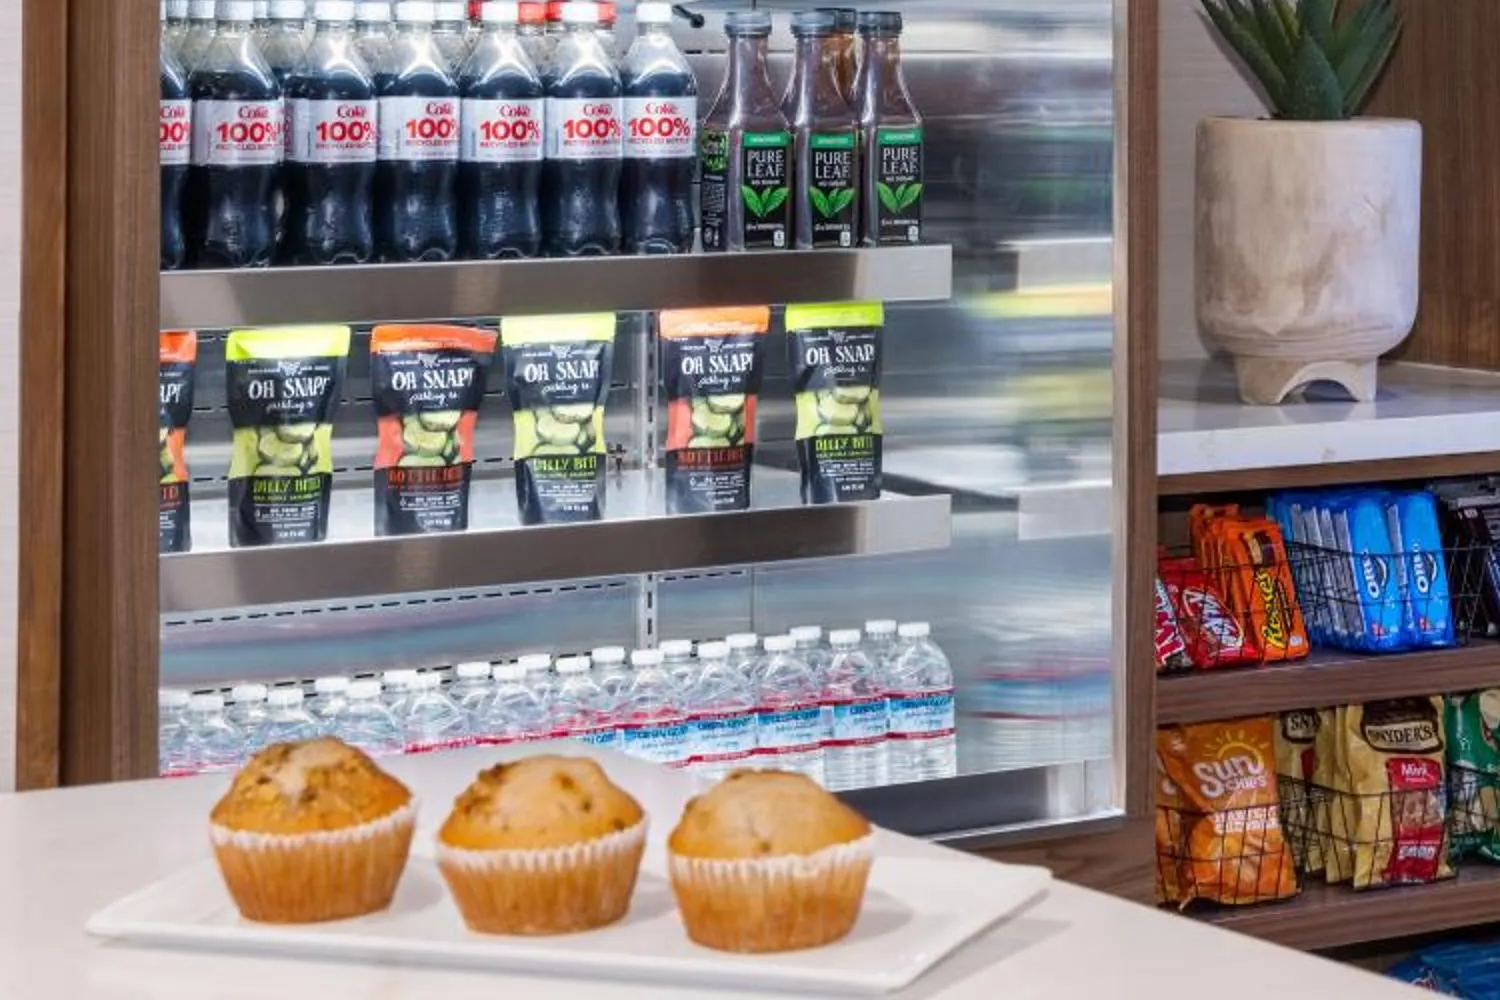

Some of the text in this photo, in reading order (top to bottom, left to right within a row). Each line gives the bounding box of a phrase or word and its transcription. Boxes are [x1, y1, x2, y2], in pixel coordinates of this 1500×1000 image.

[628, 118, 691, 137] 100%
[815, 151, 852, 165] PURE
[883, 147, 918, 160] PURE
[815, 165, 850, 179] LEAF
[883, 161, 918, 174] LEAF
[682, 356, 704, 374] OH
[806, 347, 831, 365] OH
[391, 371, 416, 391] OH
[524, 363, 549, 382] OH
[248, 380, 275, 400] OH
[1367, 725, 1433, 743] SNYDER'S
[1193, 756, 1264, 798] Sun
